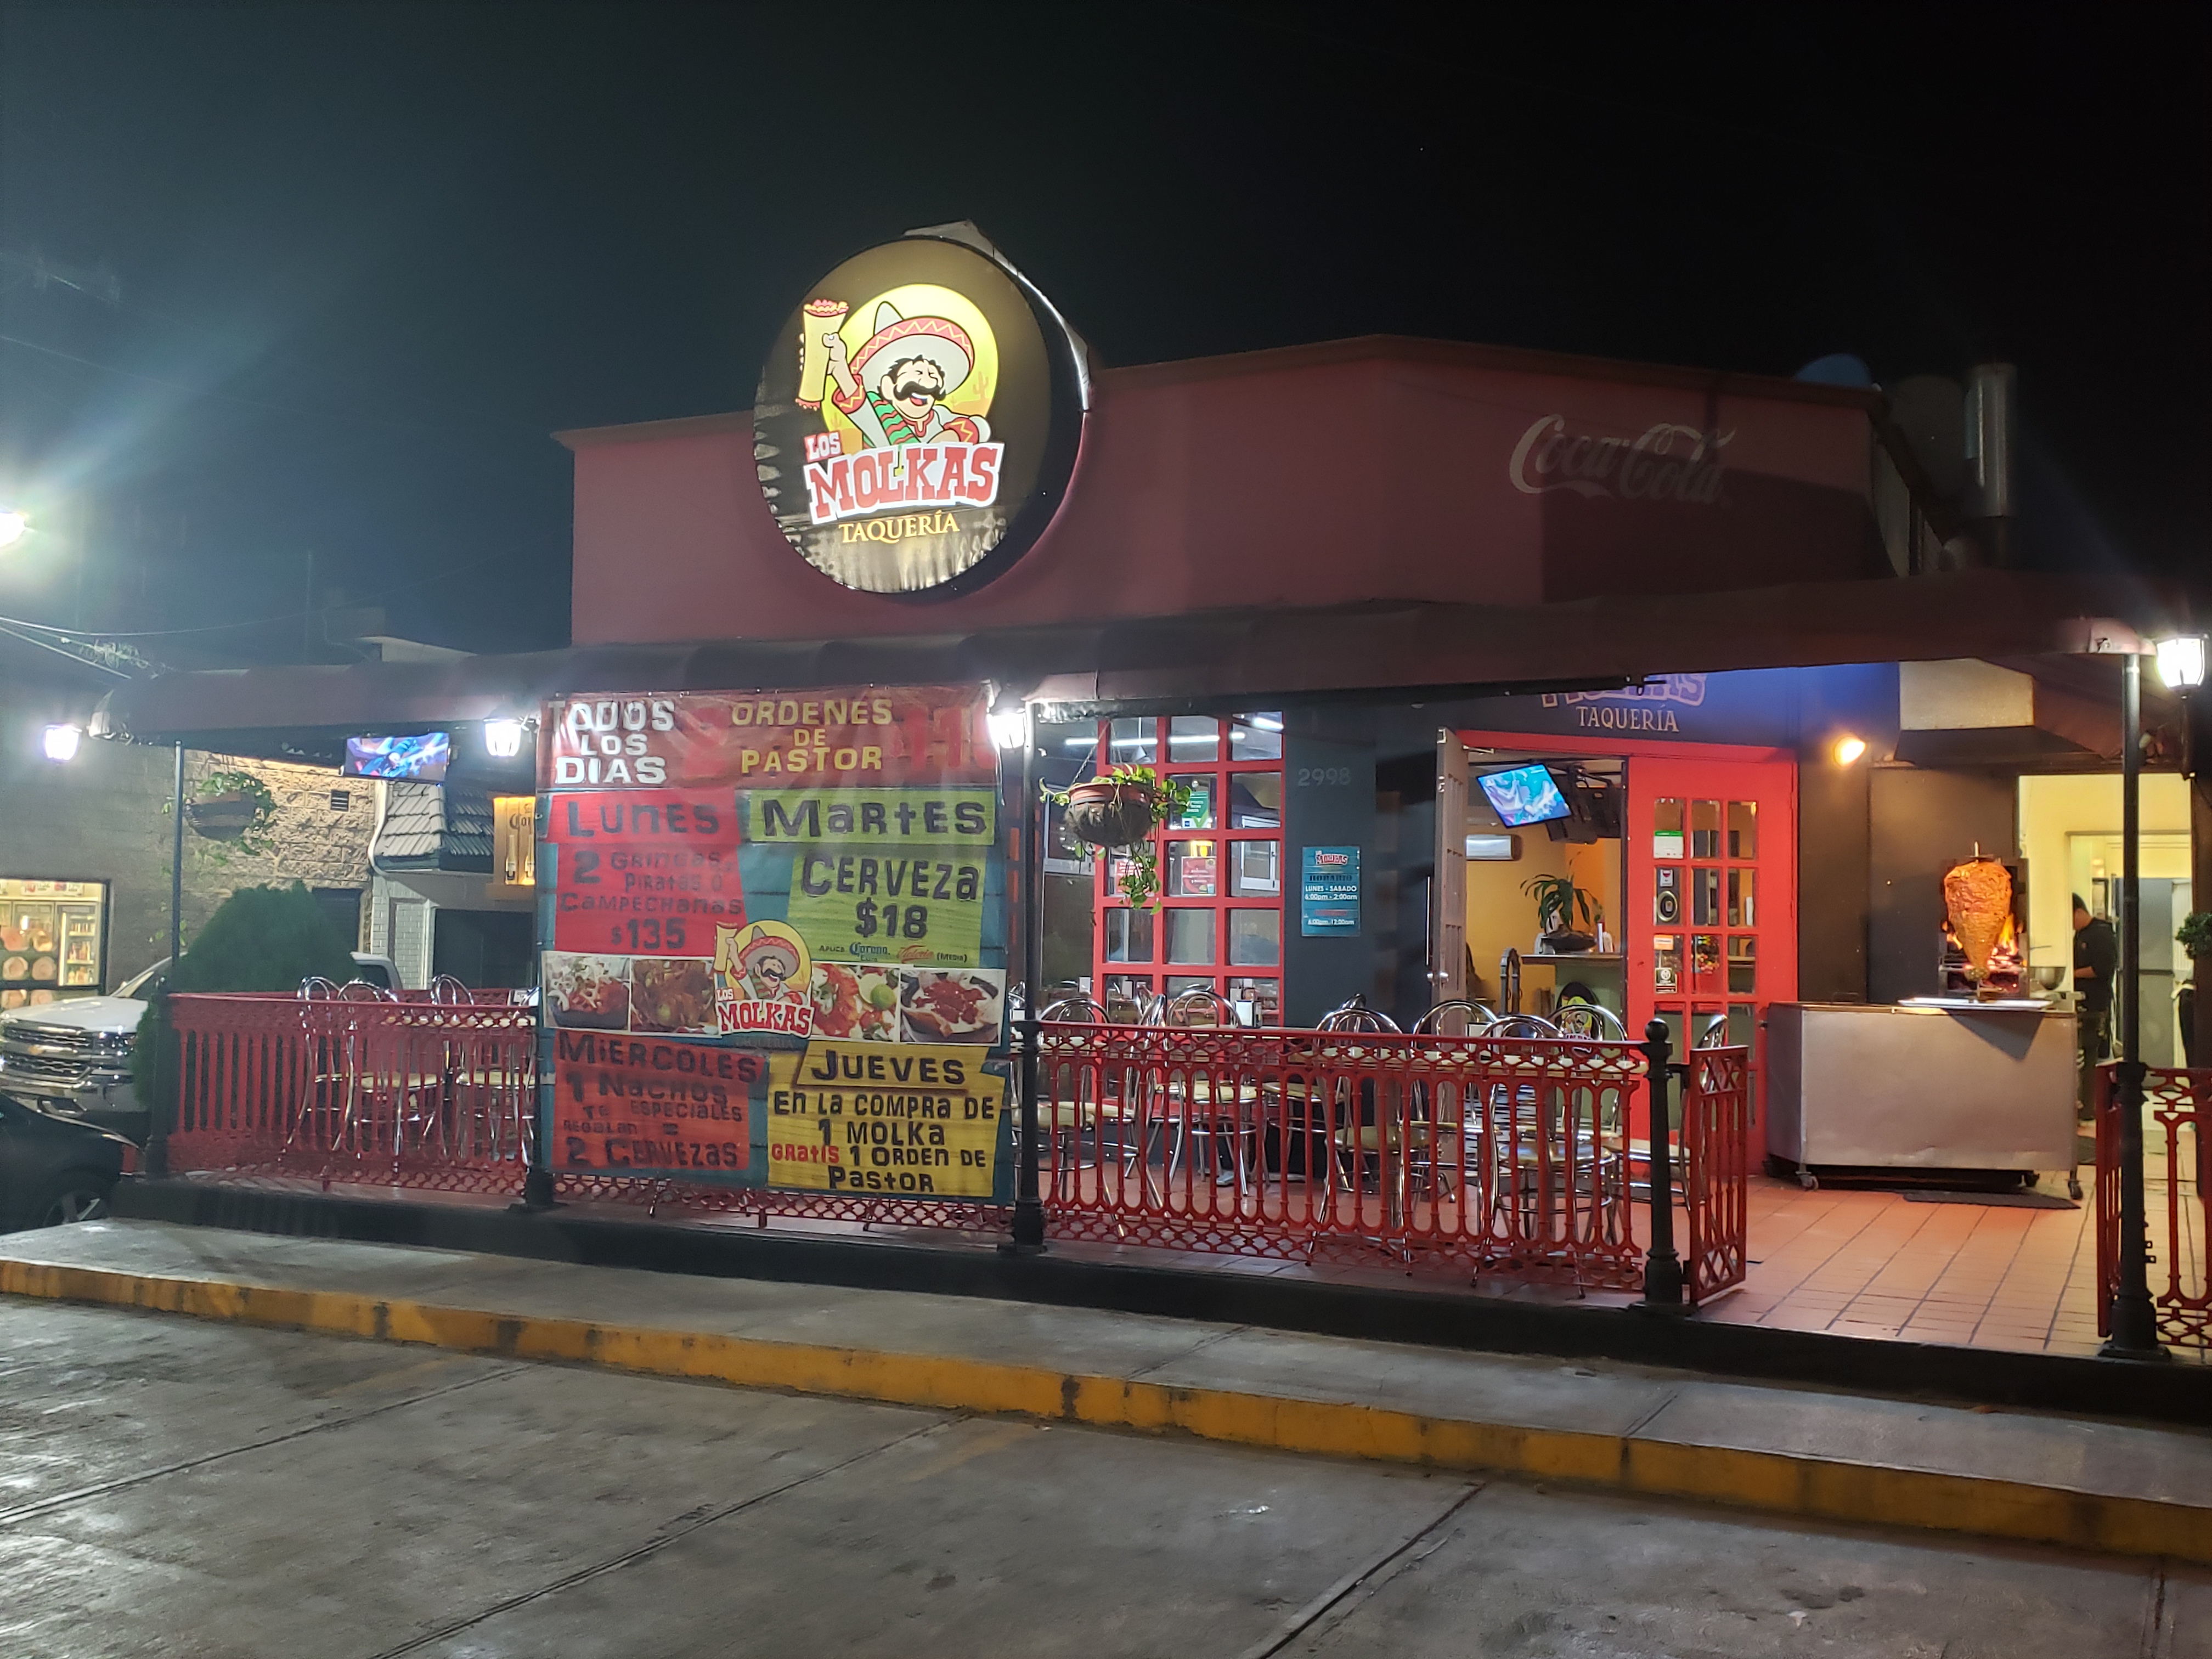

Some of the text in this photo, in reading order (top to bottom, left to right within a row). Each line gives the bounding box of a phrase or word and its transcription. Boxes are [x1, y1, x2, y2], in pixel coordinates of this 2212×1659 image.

[806, 432, 841, 460] LOS
[809, 447, 997, 518] MOLKAS
[839, 510, 960, 544] TAQUERÍA
[549, 701, 674, 731] TODOS
[732, 699, 893, 725] ORDENES
[1576, 703, 1679, 732] TAQUERÍA
[580, 733, 648, 756] LOS
[794, 729, 826, 747] DE
[556, 756, 667, 785] DIAS
[741, 746, 882, 774] PASTOR
[1298, 768, 1351, 786] 2998
[573, 850, 601, 884] 2
[855, 897, 928, 939] $18
[611, 917, 686, 950] $135
[716, 989, 733, 1001] LOS
[718, 1002, 811, 1035] MOLKAS
[811, 1049, 966, 1085] JUEVES
[567, 1071, 584, 1102] 1
[964, 1097, 994, 1119] DE
[818, 1118, 831, 1146] 1
[566, 1137, 591, 1167] 2
[850, 1146, 860, 1166] 1
[961, 1149, 986, 1167] DE
